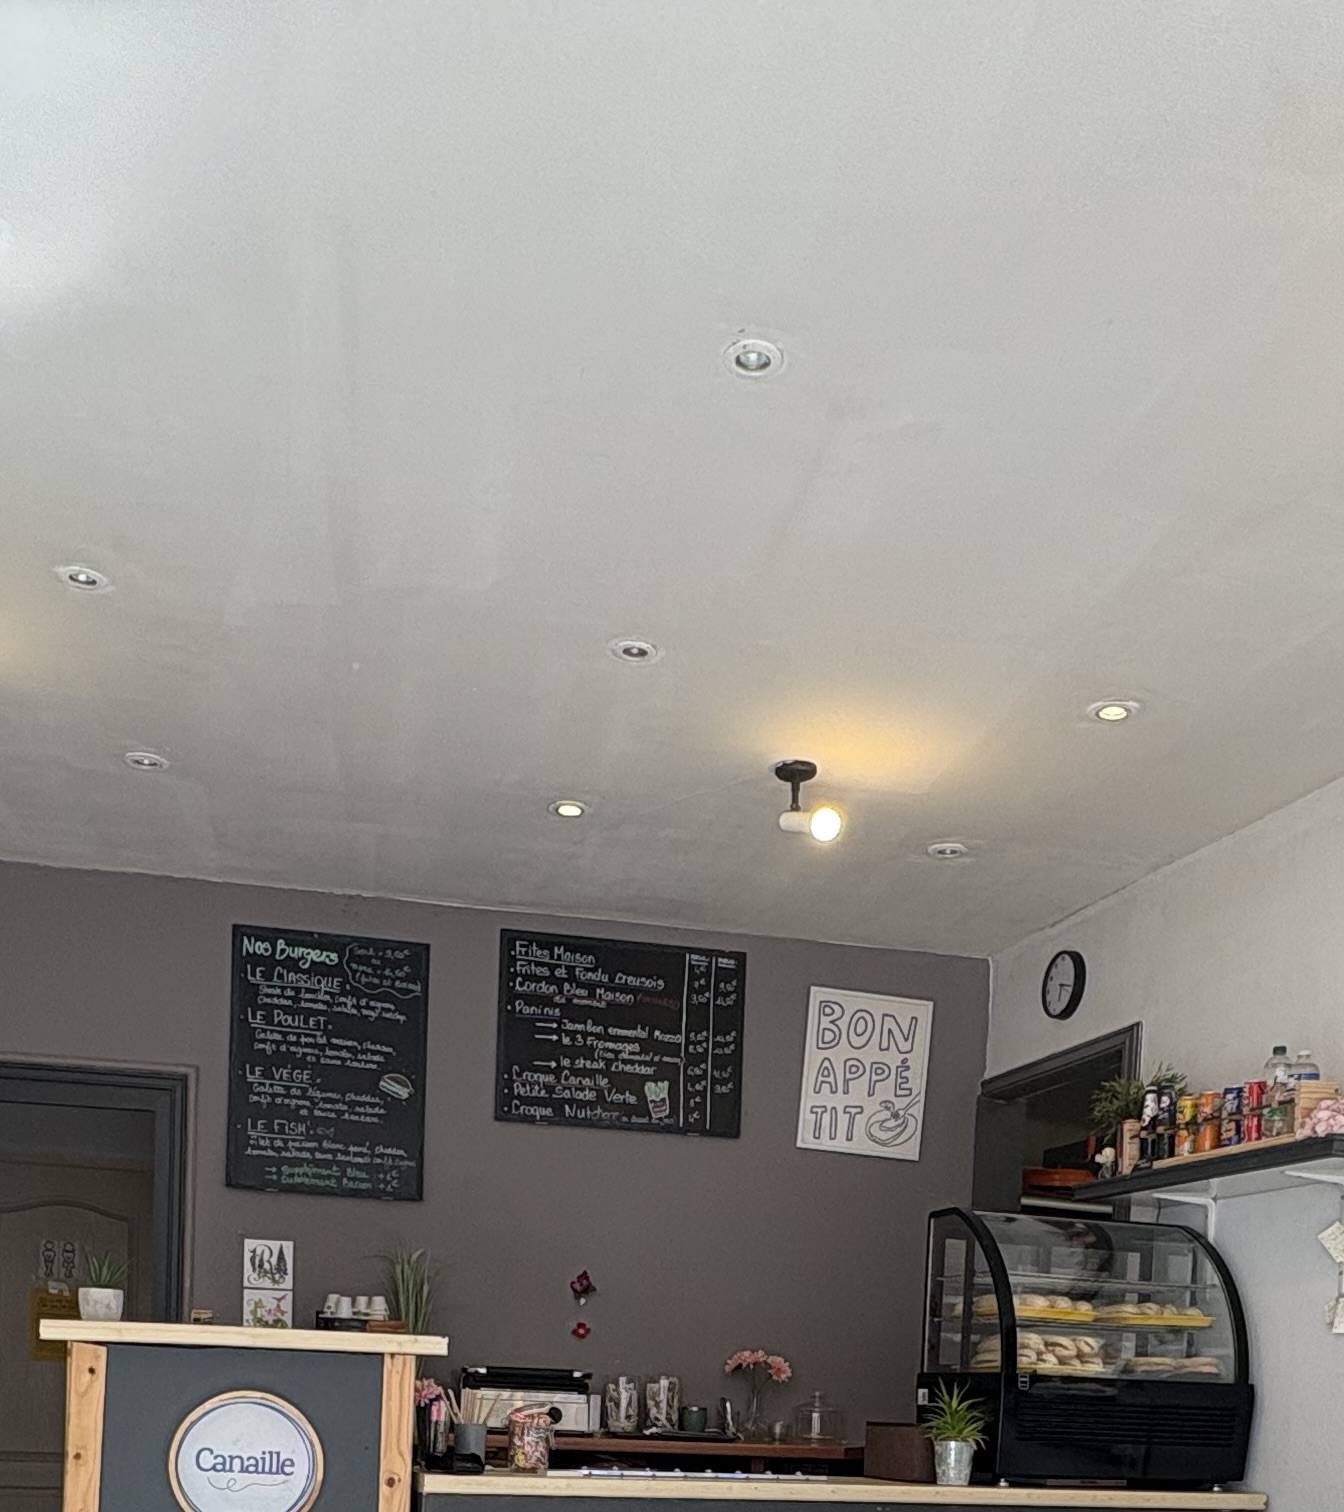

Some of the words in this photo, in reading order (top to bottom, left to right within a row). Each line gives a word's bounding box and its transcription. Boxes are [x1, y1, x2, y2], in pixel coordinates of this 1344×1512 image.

[242, 935, 272, 956] Nos
[275, 939, 339, 969] Burgers
[516, 940, 550, 960] Frites
[554, 945, 595, 964] Maison
[247, 964, 266, 981] LE
[516, 961, 550, 977] Frites
[554, 965, 568, 978] et
[514, 976, 558, 994] Cordon
[563, 982, 588, 996] Bleu
[596, 987, 634, 1004] Maison
[247, 1007, 266, 1023] LE
[515, 1000, 561, 1016] Paninis
[816, 1000, 918, 1054] BON
[574, 1034, 584, 1045] 3
[246, 1063, 264, 1079] LE
[512, 1065, 557, 1088] Croque
[561, 1070, 611, 1087] Canaille
[813, 1057, 913, 1098] APPÉ
[513, 1082, 549, 1097] Petite
[552, 1086, 597, 1101] Salade
[604, 1088, 638, 1104] Verte
[512, 1099, 554, 1120] Croque
[247, 1118, 268, 1132] LE
[810, 1105, 864, 1141] TIT
[195, 1447, 295, 1476] Canaille
